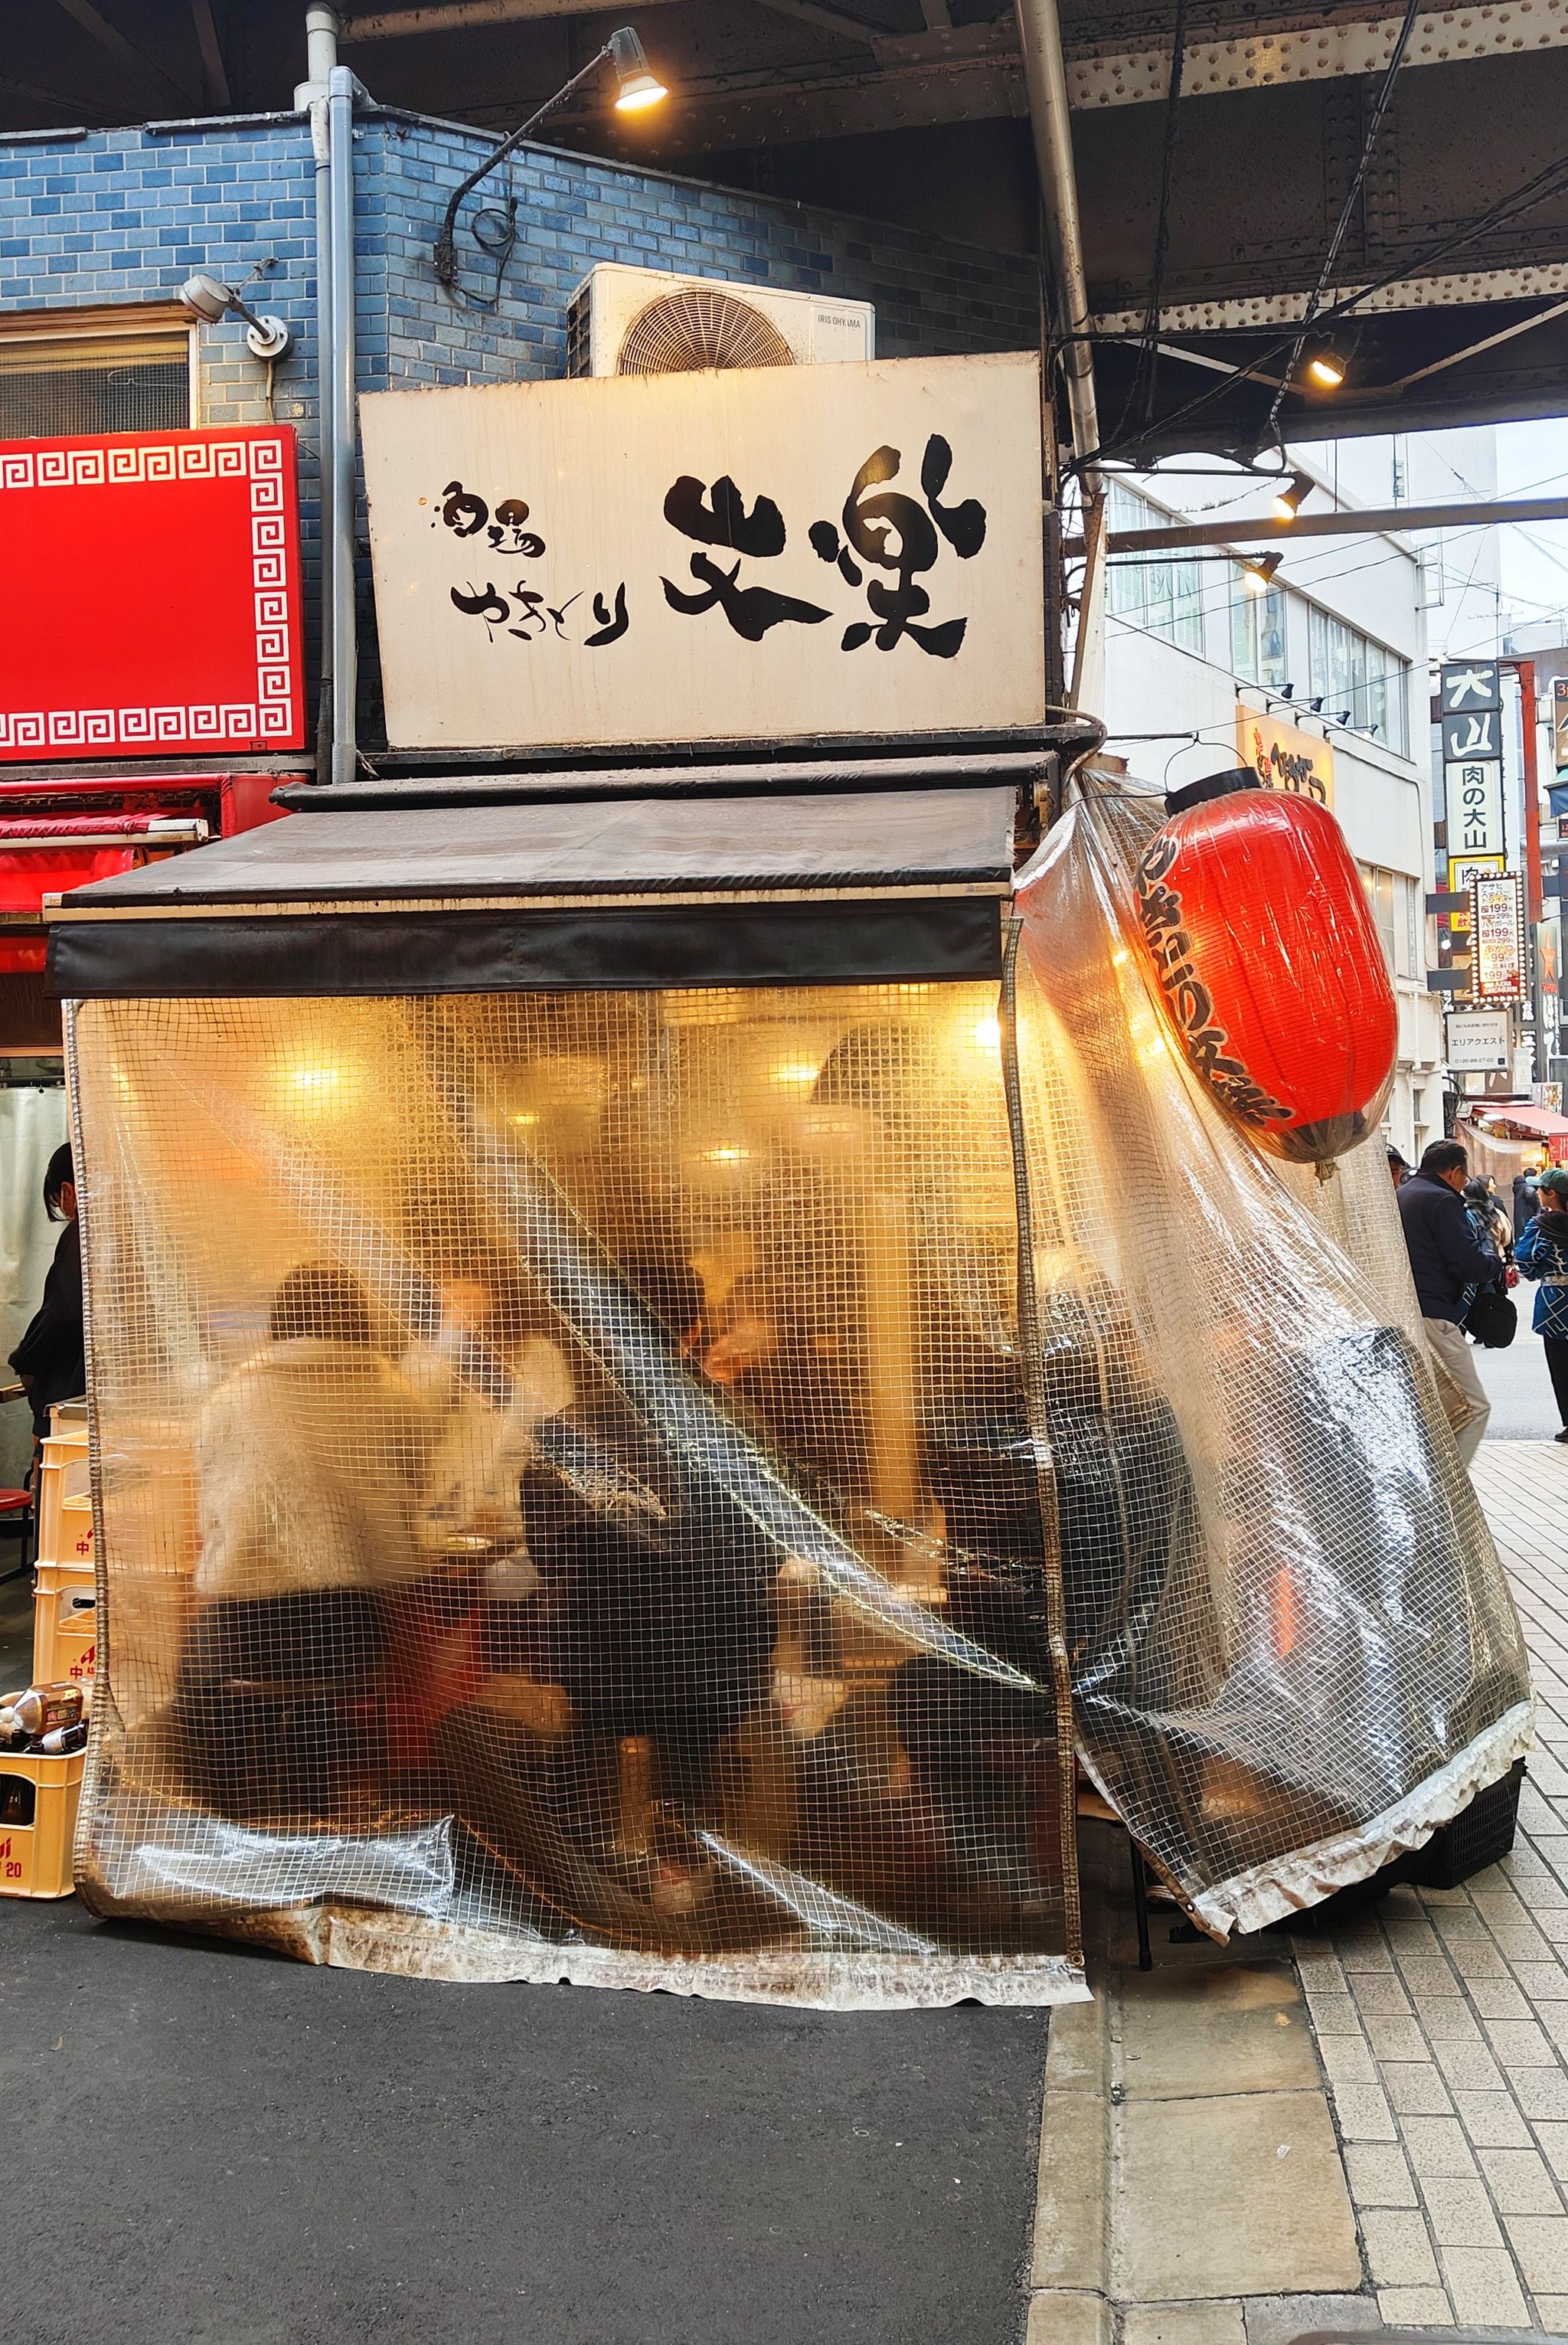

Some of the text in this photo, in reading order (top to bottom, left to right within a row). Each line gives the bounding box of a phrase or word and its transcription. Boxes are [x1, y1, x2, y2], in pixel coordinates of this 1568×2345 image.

[818, 314, 861, 329] IRIS OHYAMA
[431, 480, 546, 558] 酒場
[658, 433, 988, 659] 文楽
[450, 579, 630, 647] やきとり
[1446, 669, 1494, 757] 大山
[1462, 766, 1487, 849] 肉の大山
[1452, 1037, 1505, 1046] エリアクエスト
[77, 1541, 90, 1555] 中
[70, 1665, 83, 1679] 中
[6, 1862, 21, 1878] 20
